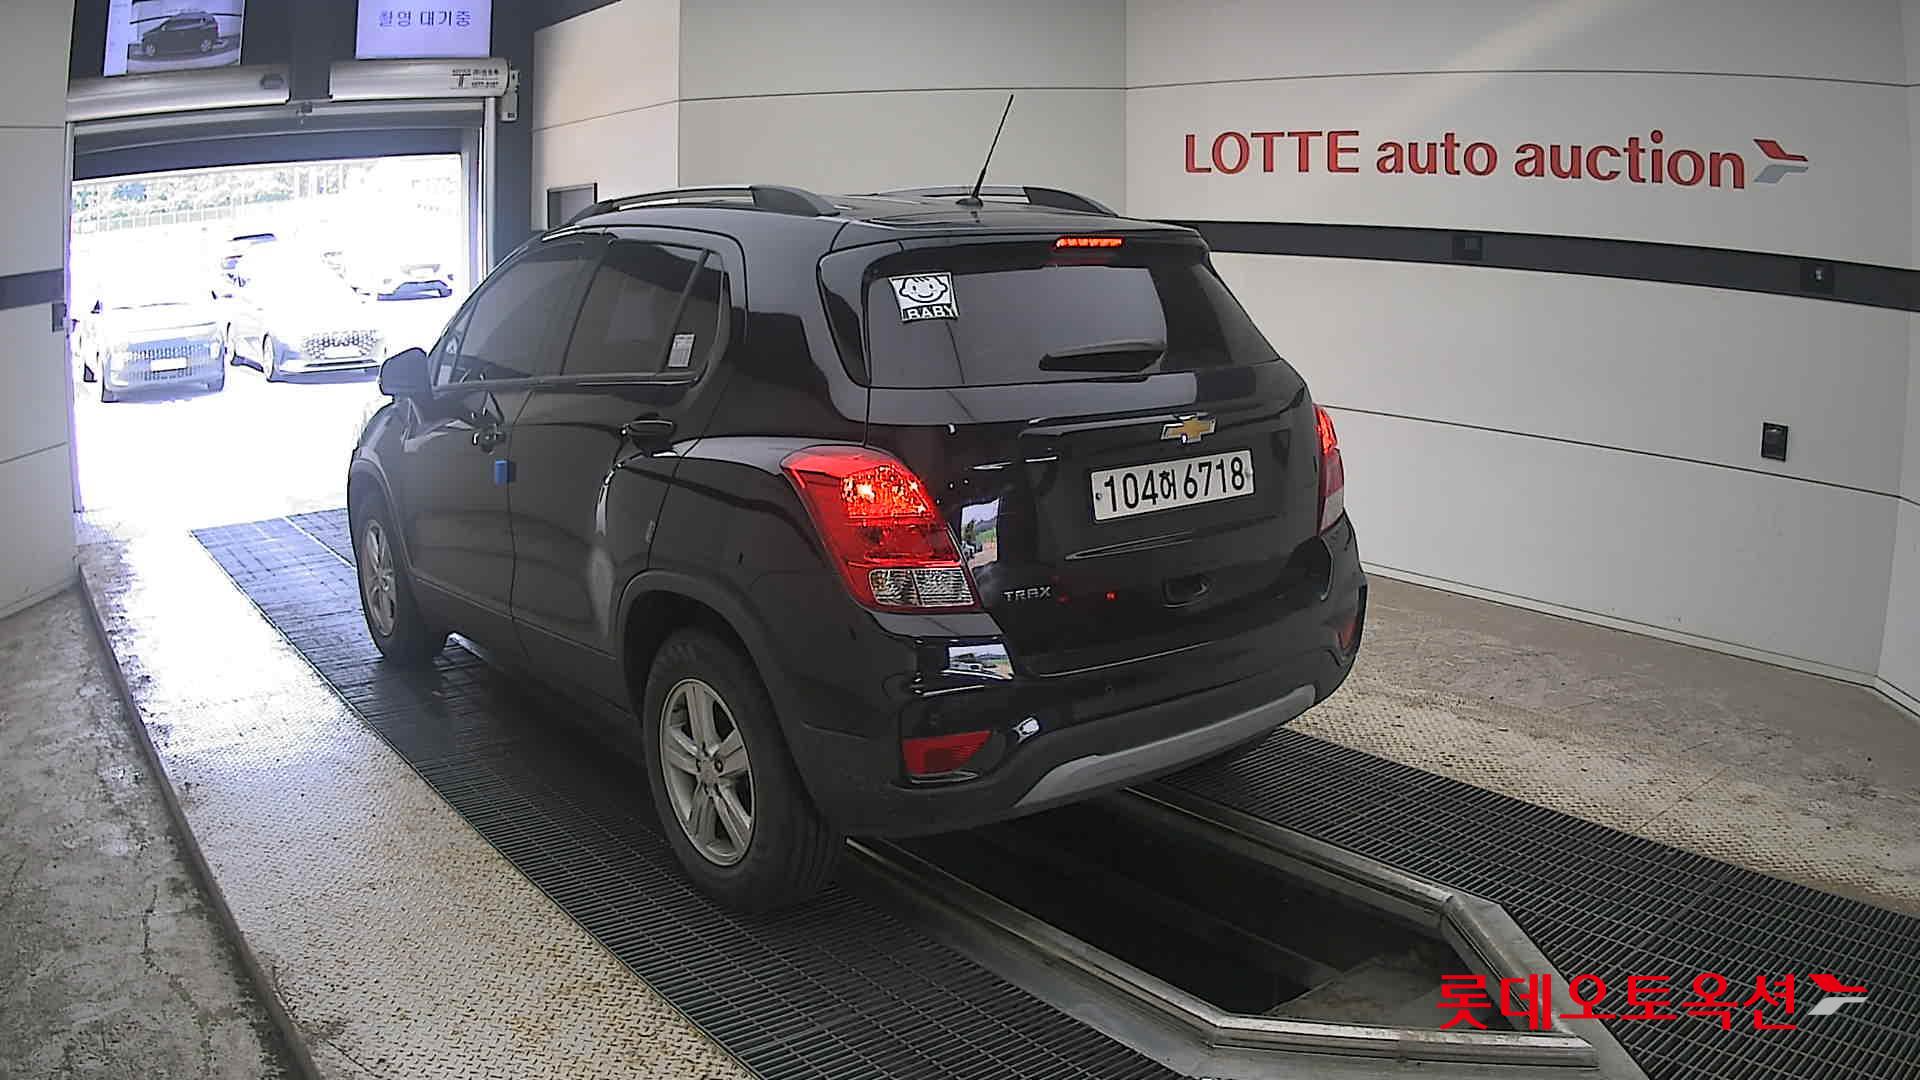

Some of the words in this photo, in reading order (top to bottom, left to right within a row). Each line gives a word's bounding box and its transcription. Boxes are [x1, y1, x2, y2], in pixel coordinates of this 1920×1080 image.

[1184, 130, 1360, 175] LOTTE
[1375, 132, 1498, 177] auto
[1513, 130, 1746, 189] auction
[906, 304, 954, 320] BABY
[1003, 586, 1052, 602] TRAX
